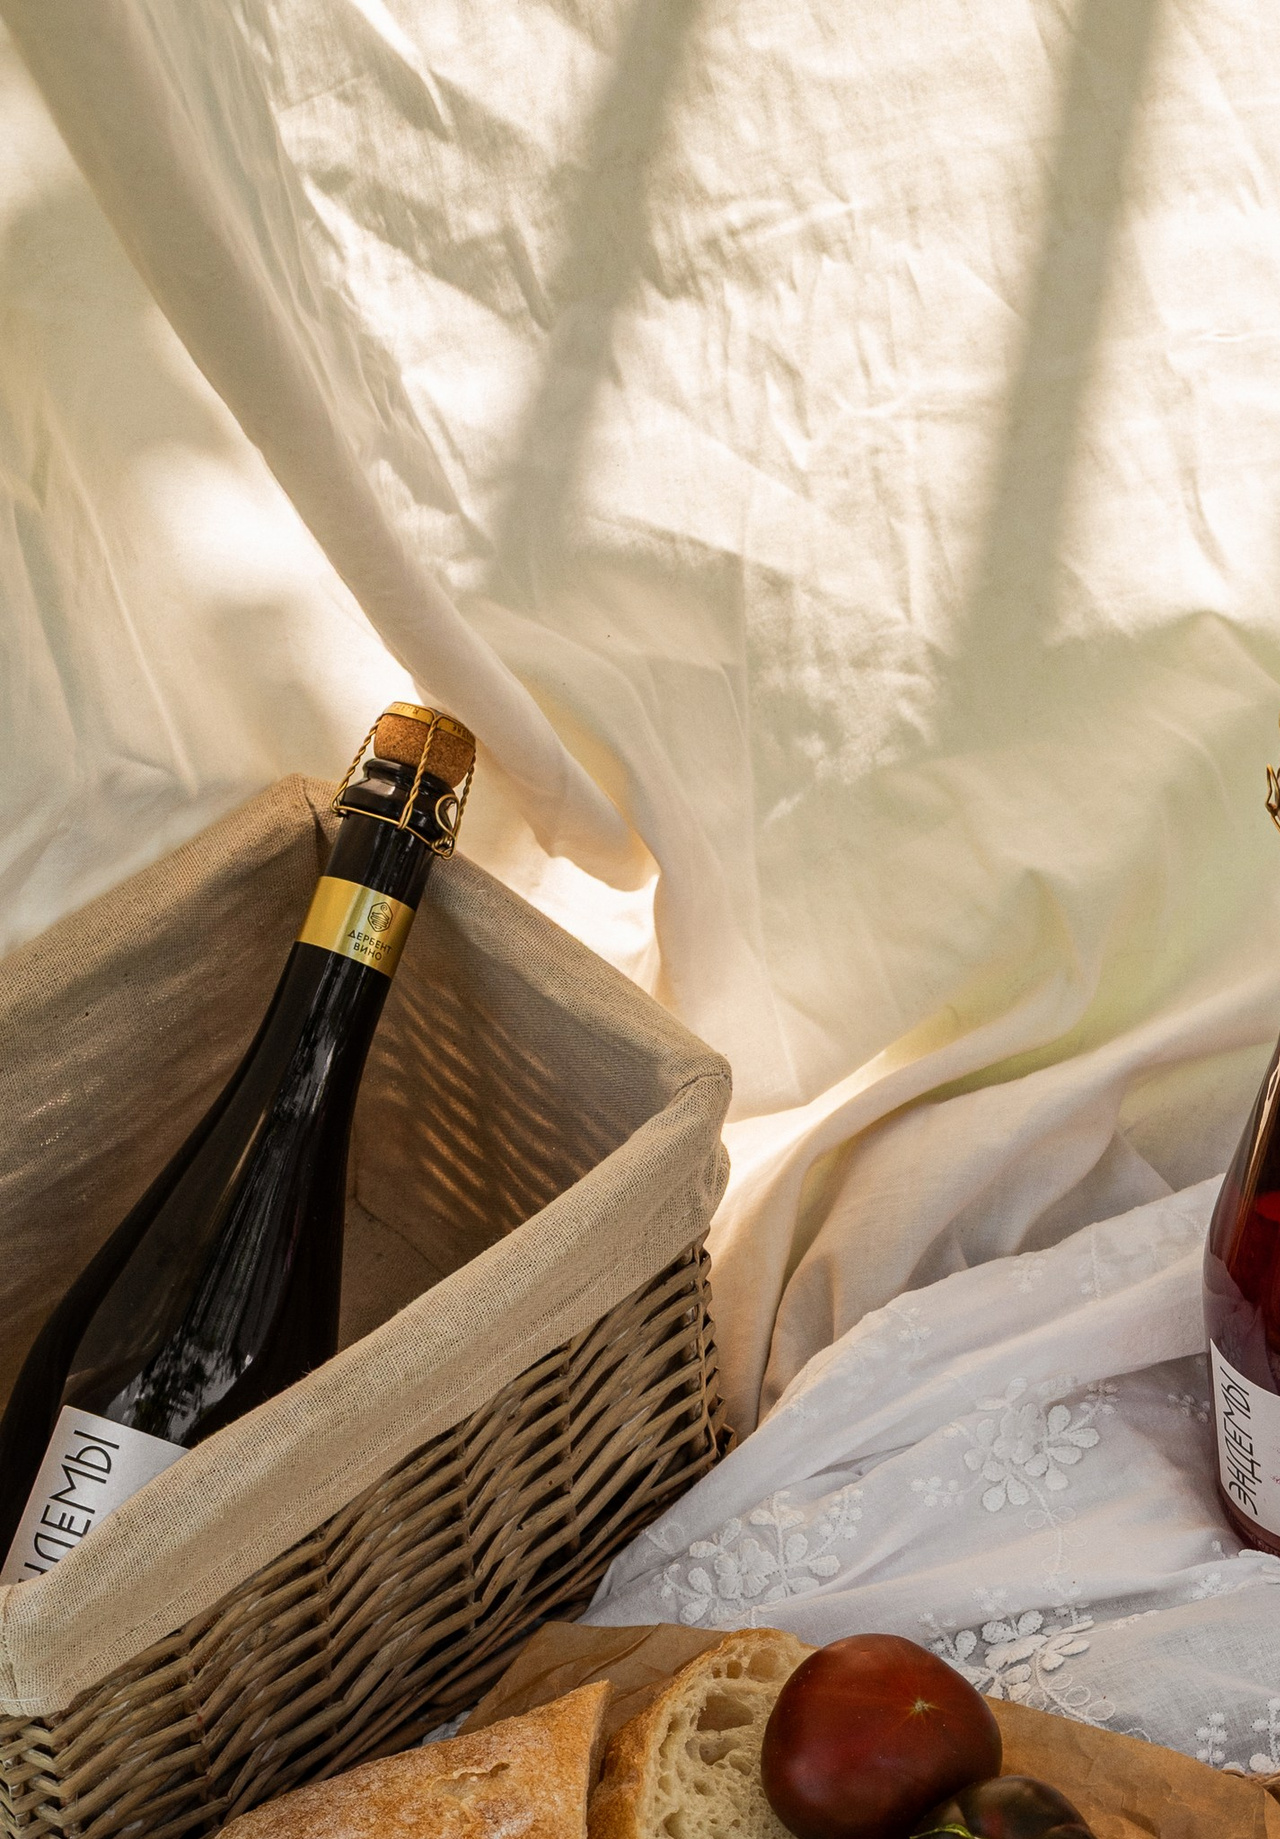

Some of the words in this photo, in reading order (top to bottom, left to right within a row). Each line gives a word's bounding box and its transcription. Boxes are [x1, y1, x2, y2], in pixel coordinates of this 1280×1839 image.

[347, 929, 393, 955] ДЕРБЕНТ
[353, 942, 383, 961] ВИНО
[1219, 1365, 1264, 1516] ЭНДЕМЫ
[17, 1429, 120, 1584] ДЕМЫ
